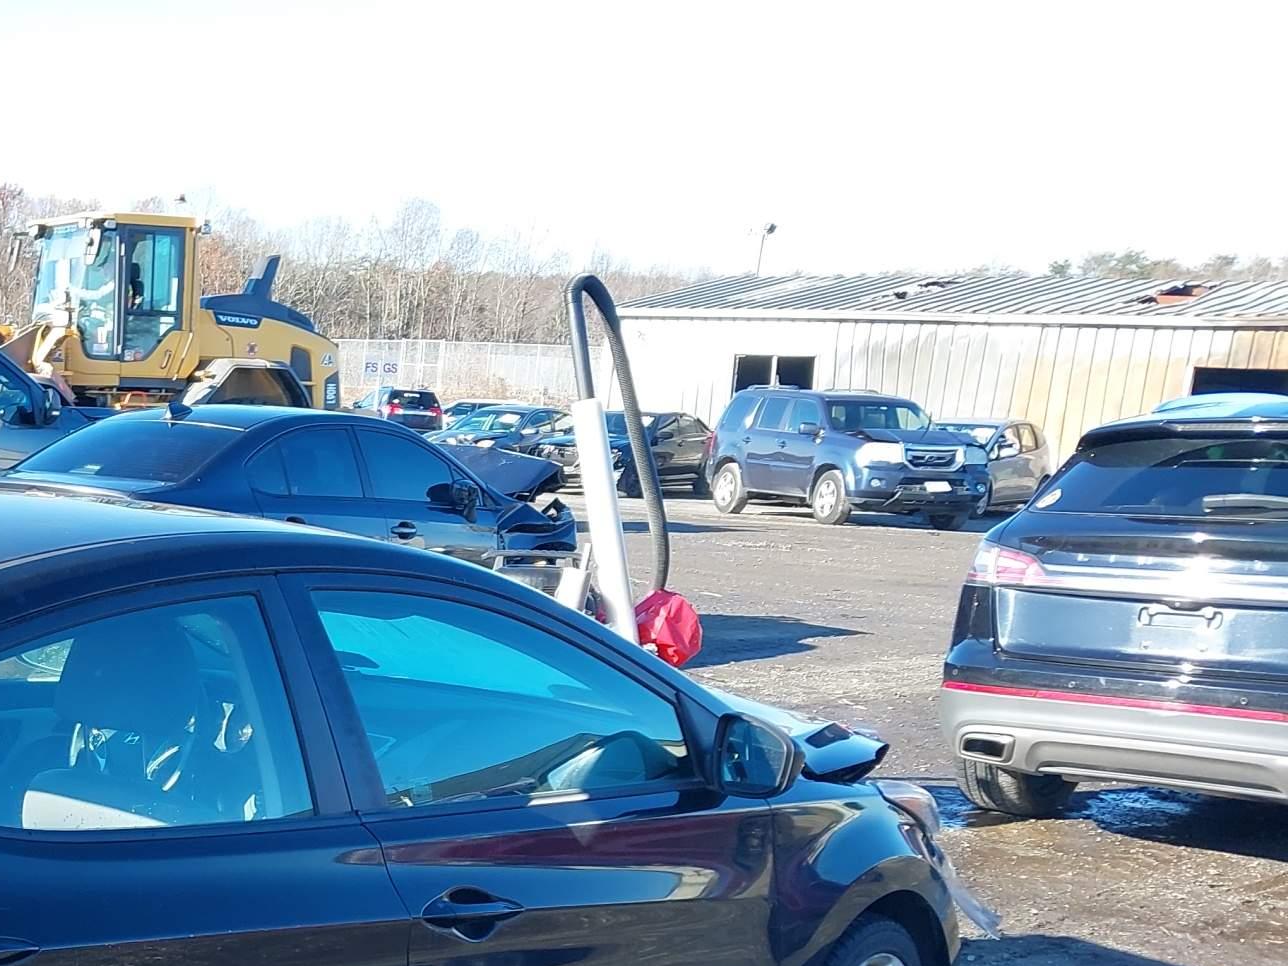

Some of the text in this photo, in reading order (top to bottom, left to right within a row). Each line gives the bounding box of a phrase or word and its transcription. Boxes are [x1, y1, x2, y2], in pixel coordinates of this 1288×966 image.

[217, 314, 259, 326] VOLVO
[365, 362, 378, 373] FS
[383, 363, 398, 374] GS
